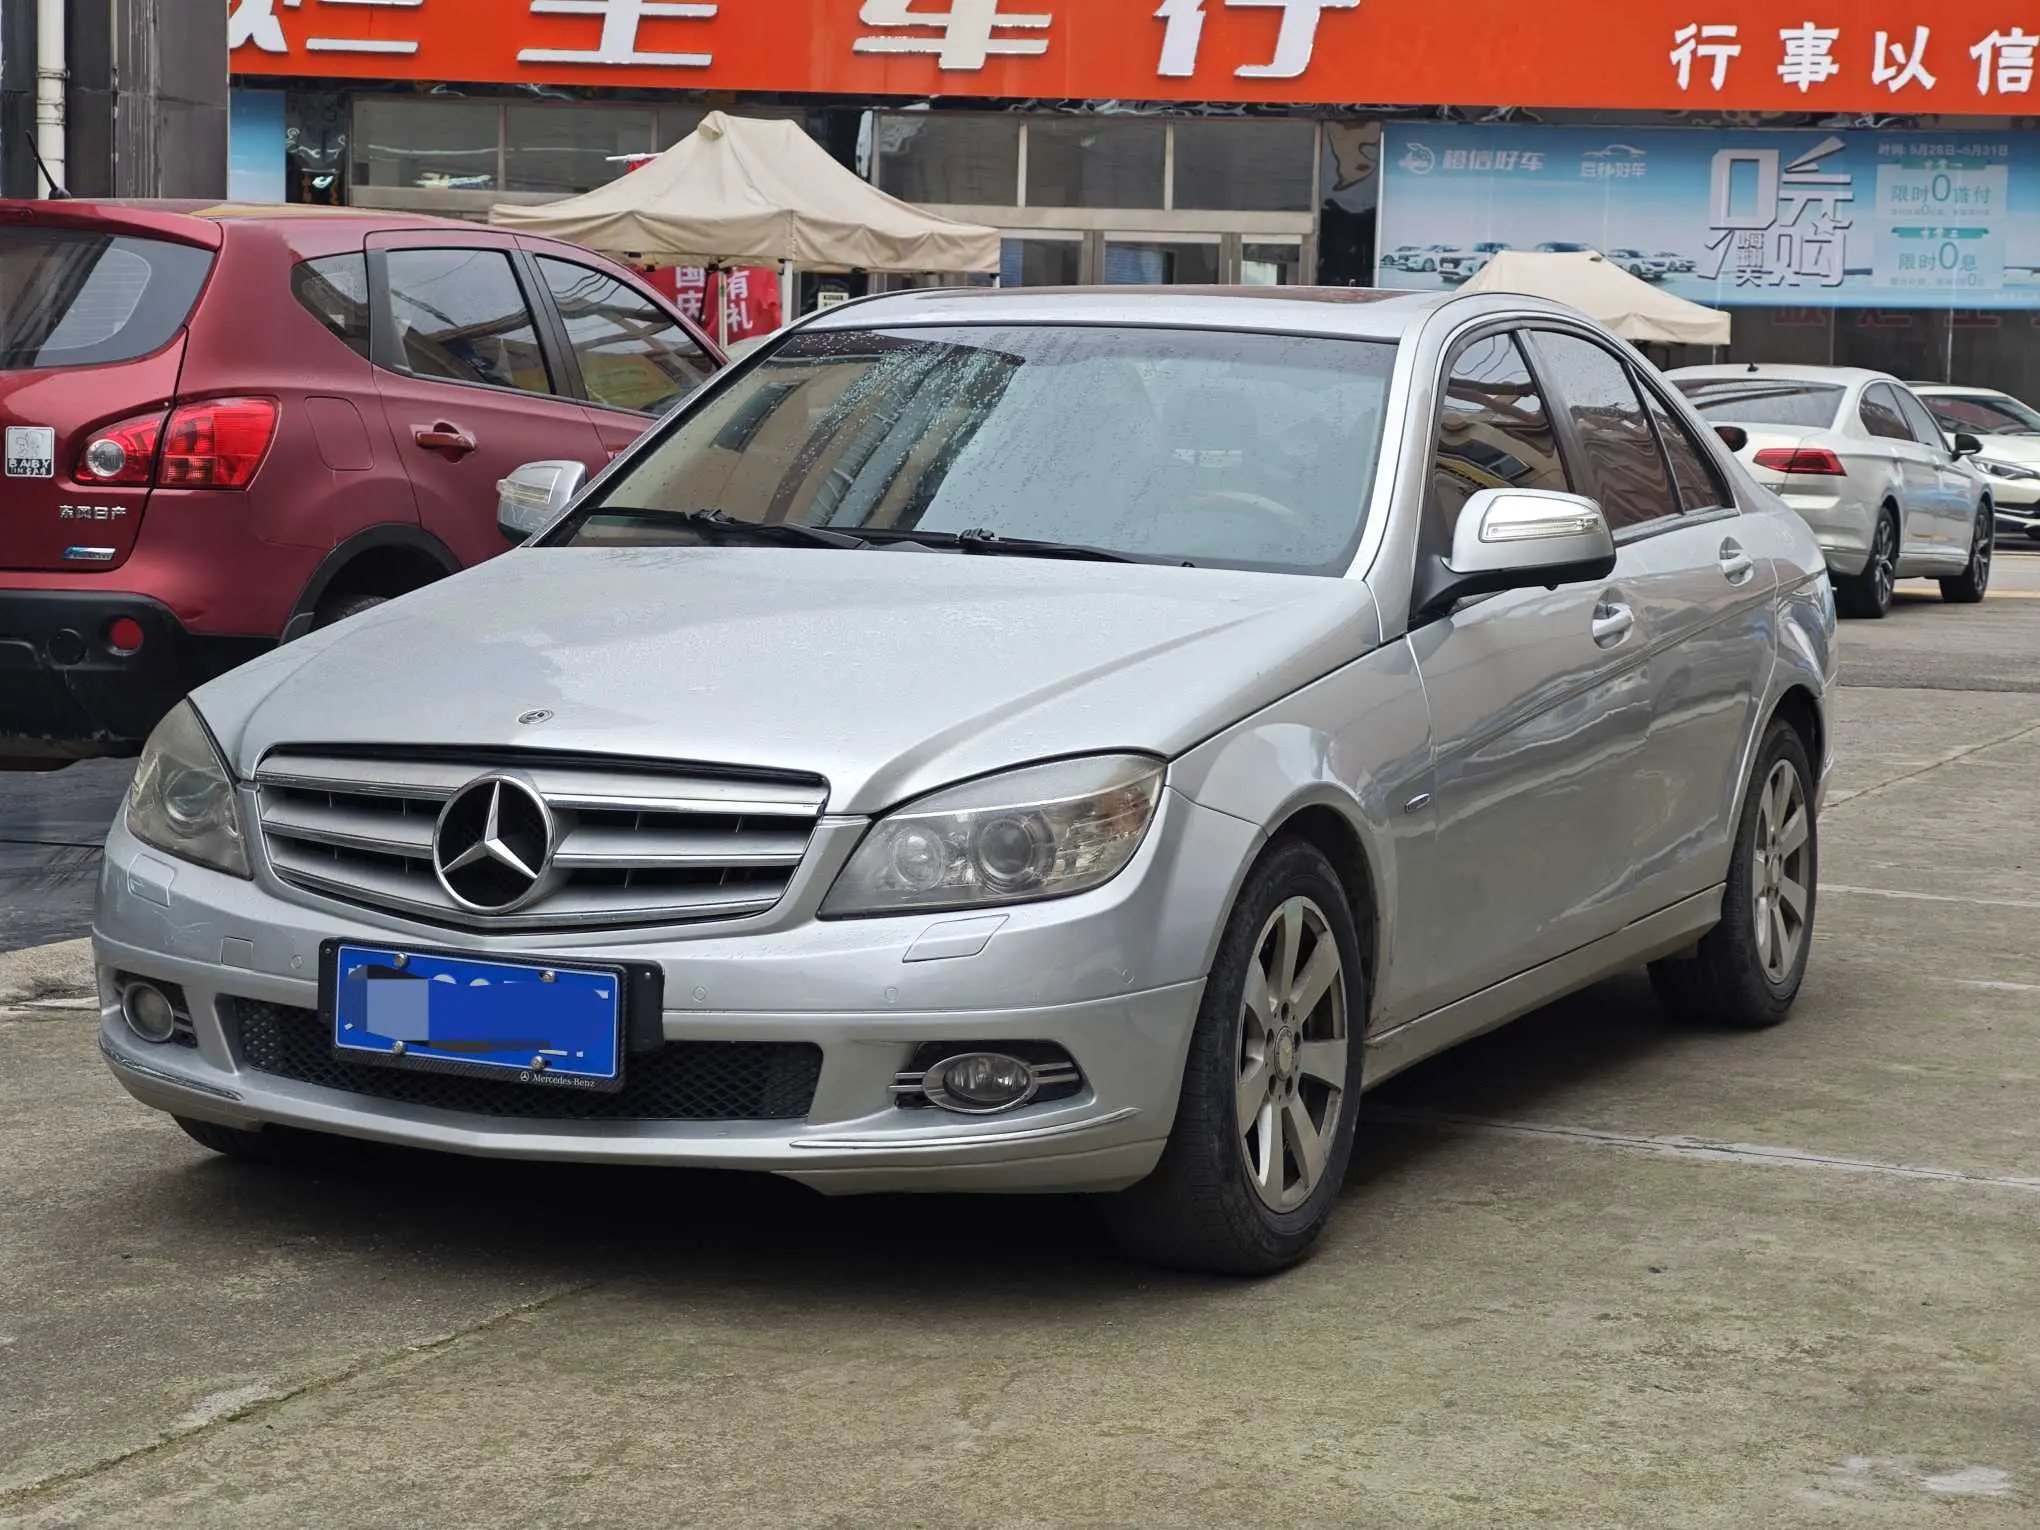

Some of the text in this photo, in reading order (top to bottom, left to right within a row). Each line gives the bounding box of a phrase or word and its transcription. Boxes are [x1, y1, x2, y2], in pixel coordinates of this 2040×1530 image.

[1669, 21, 2040, 96] 行事以信
[726, 269, 753, 333] 有礼
[58, 505, 127, 520] 东风日产
